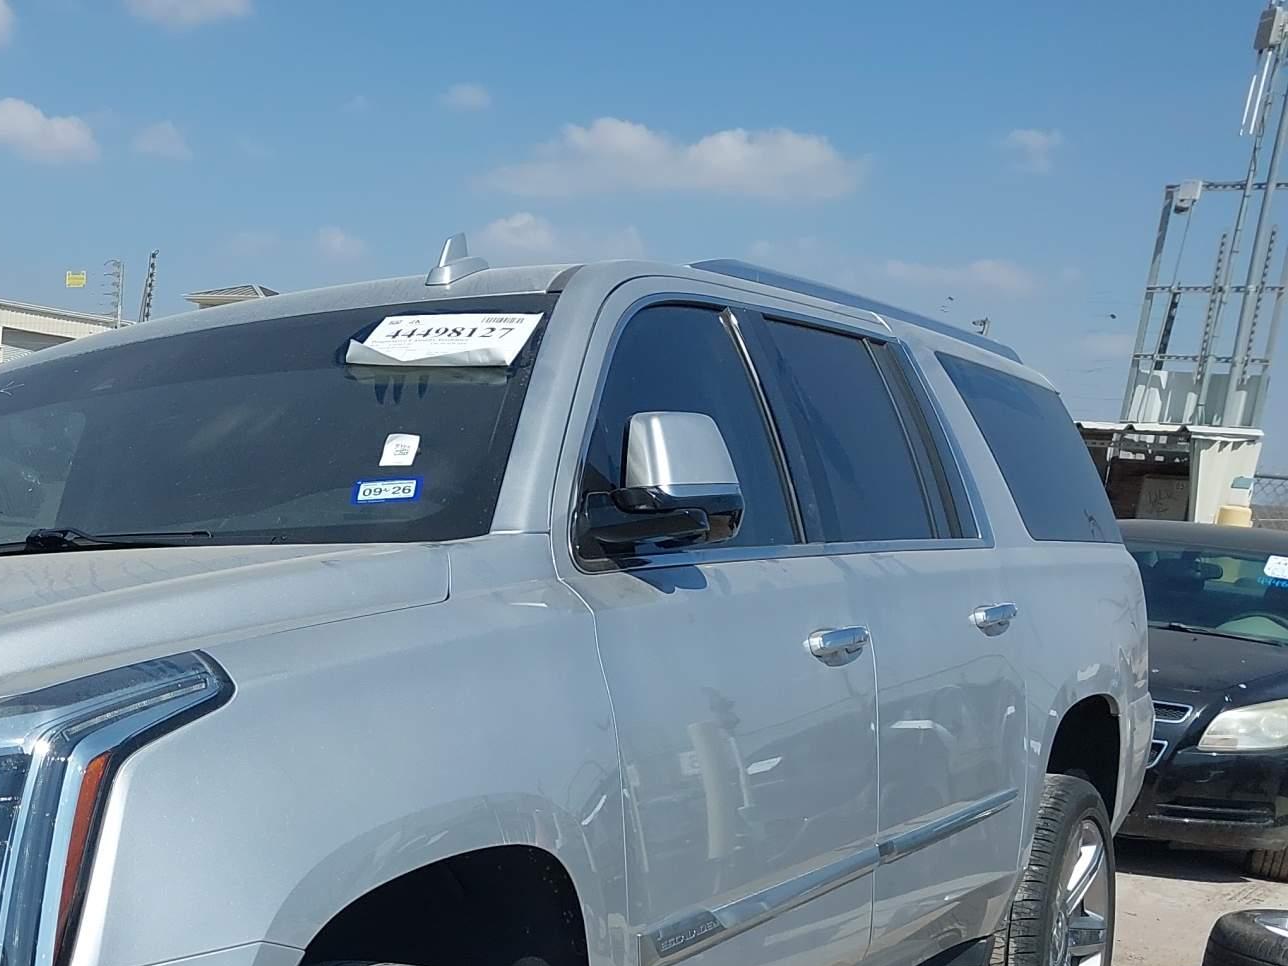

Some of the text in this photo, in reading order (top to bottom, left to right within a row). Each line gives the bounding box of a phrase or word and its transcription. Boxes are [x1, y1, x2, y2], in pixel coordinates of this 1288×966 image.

[385, 326, 515, 339] 44498127
[362, 485, 412, 497] 09 26
